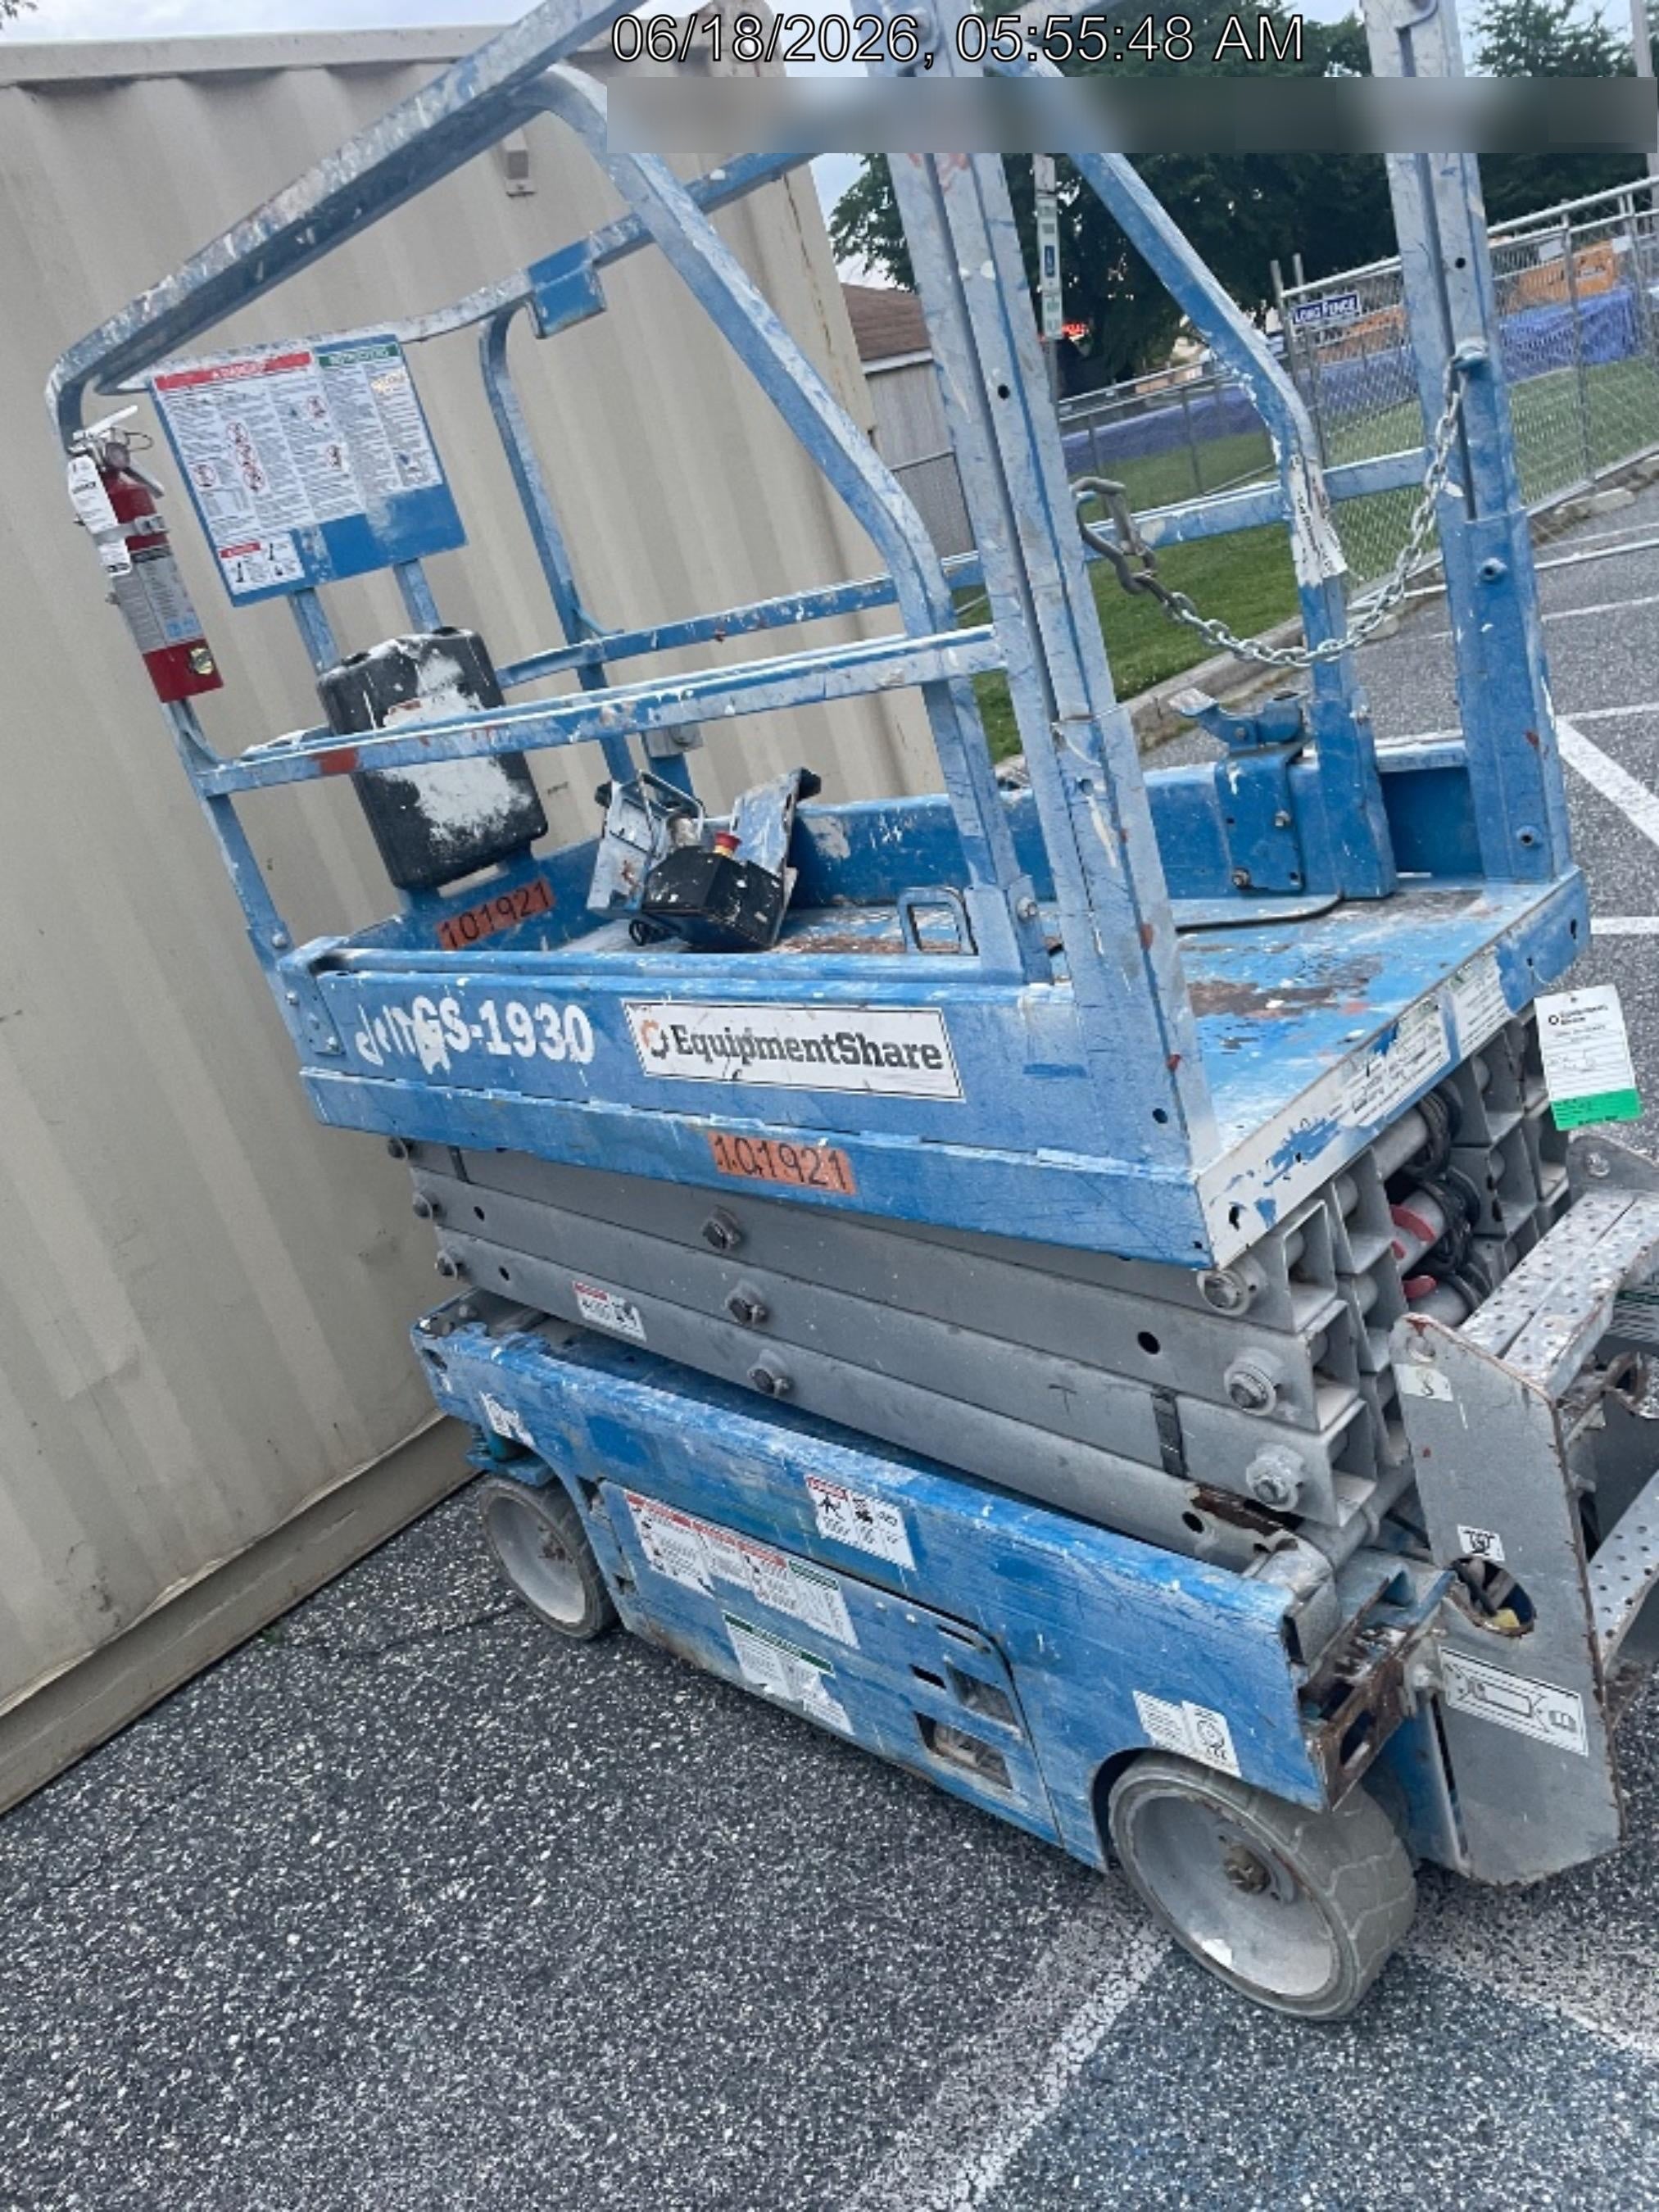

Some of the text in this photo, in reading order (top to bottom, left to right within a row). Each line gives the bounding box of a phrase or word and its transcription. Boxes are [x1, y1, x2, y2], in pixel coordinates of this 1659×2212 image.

[441, 880, 550, 950] 101921
[411, 995, 596, 1065] GS-1930
[669, 1024, 944, 1070] EquipmentShare
[714, 1135, 848, 1190] 101921
